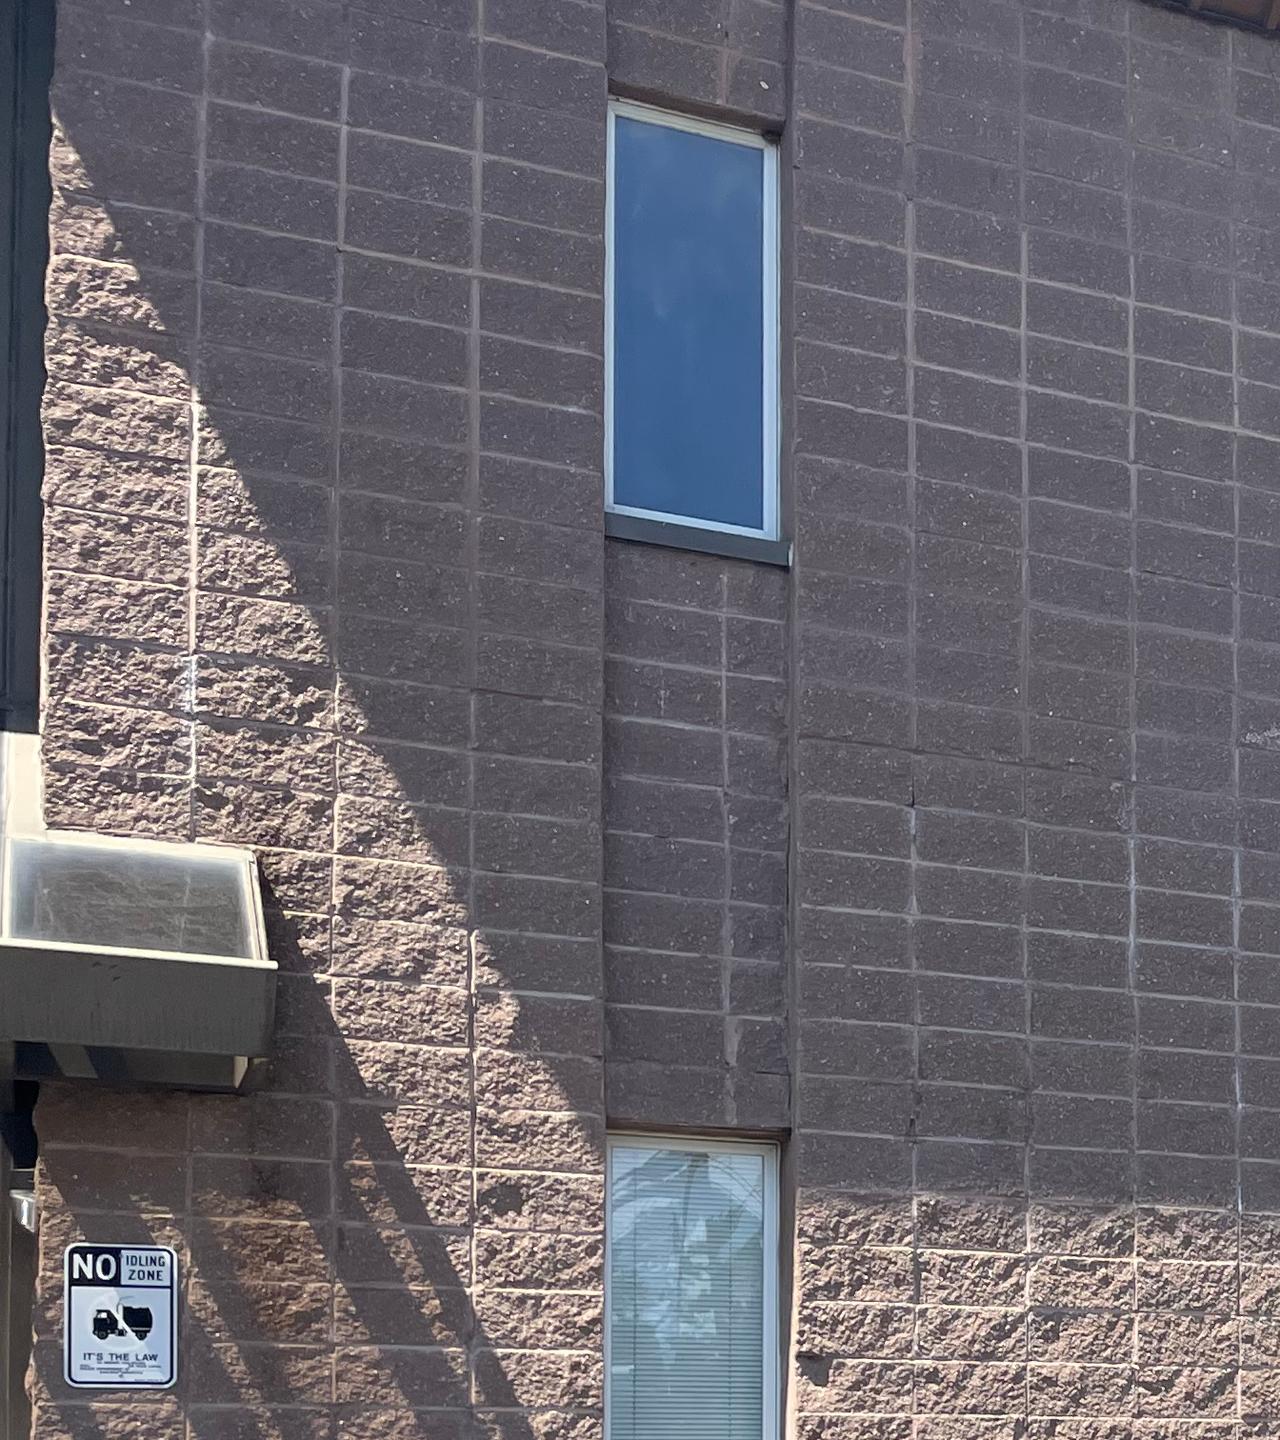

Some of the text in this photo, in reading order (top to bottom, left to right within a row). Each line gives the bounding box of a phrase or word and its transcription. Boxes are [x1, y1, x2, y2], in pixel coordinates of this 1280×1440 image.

[125, 1254, 166, 1267] IDLING
[72, 1253, 117, 1281] NO
[128, 1269, 164, 1281] ZONE
[83, 1352, 159, 1362] IT'S THE LAW
